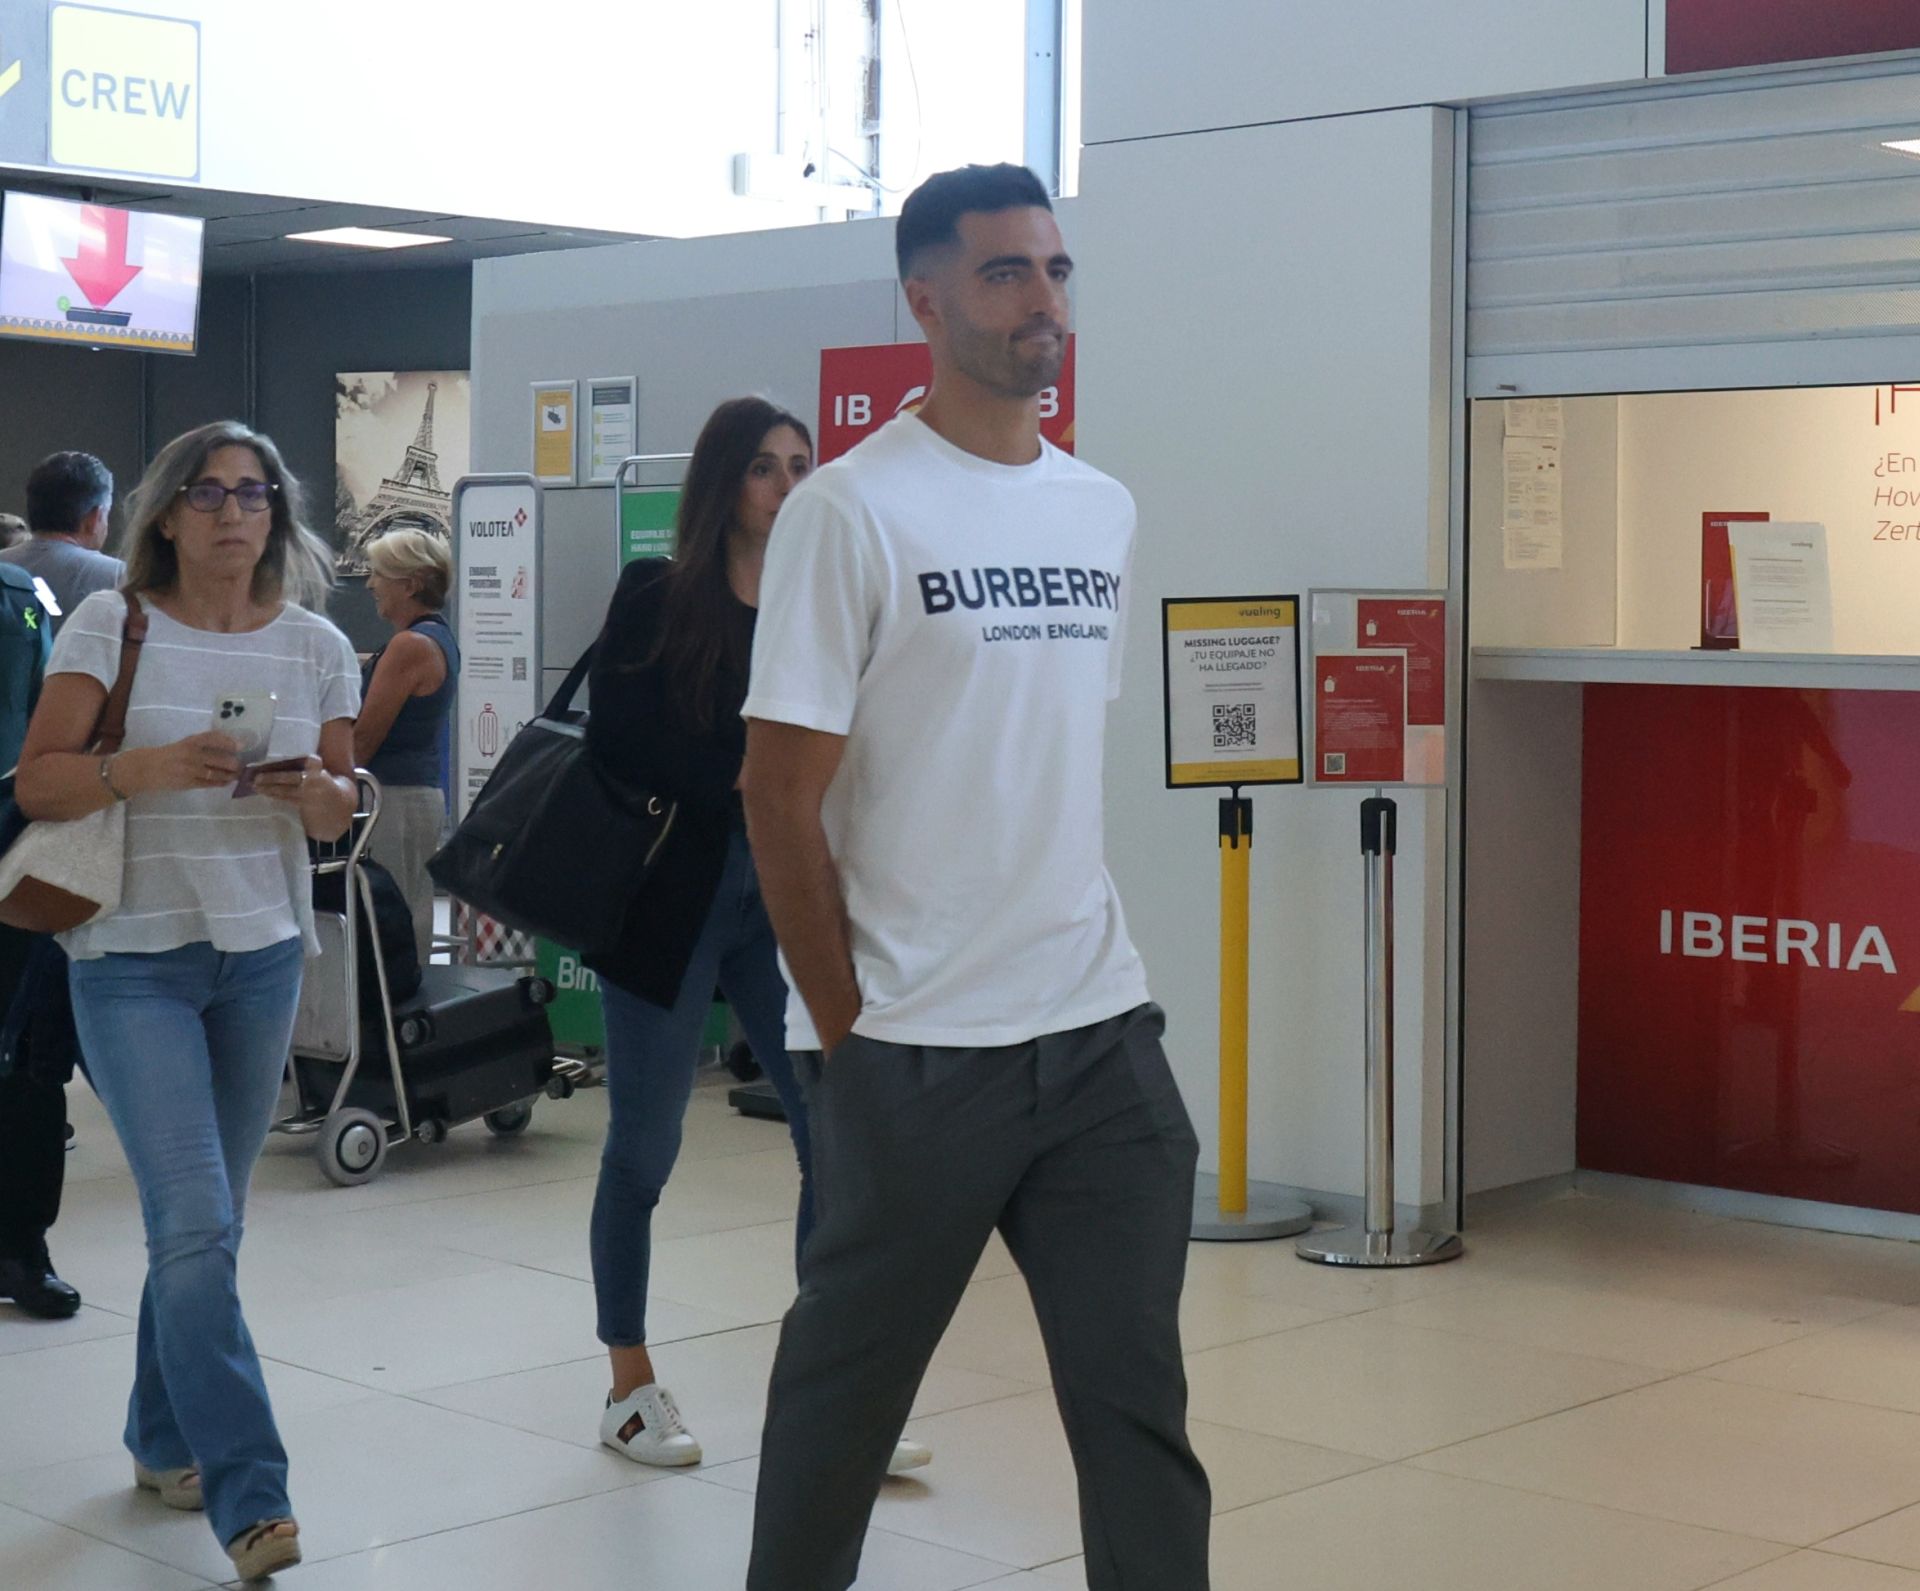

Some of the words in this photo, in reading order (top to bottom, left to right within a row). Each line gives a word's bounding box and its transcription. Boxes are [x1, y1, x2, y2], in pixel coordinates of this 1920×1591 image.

[60, 68, 191, 120] CREW
[1874, 452, 1916, 477] ¿En
[469, 520, 514, 538] VOLOTEA
[918, 567, 1120, 615] BURBERRY
[1238, 606, 1281, 619] vueling
[982, 624, 1041, 642] LONDON
[1047, 623, 1108, 641] ENGLAND
[1184, 638, 1226, 648] MISSING
[1229, 636, 1280, 646] LUGGAGE?
[1190, 651, 1207, 663] ¿TU
[1209, 649, 1256, 661] EQUIPAJE
[1259, 648, 1275, 657] NO
[1199, 663, 1214, 672] HA
[1216, 661, 1267, 672] LLEGADO?
[1660, 909, 1897, 974] IBERIA
[557, 956, 602, 992] Bin
